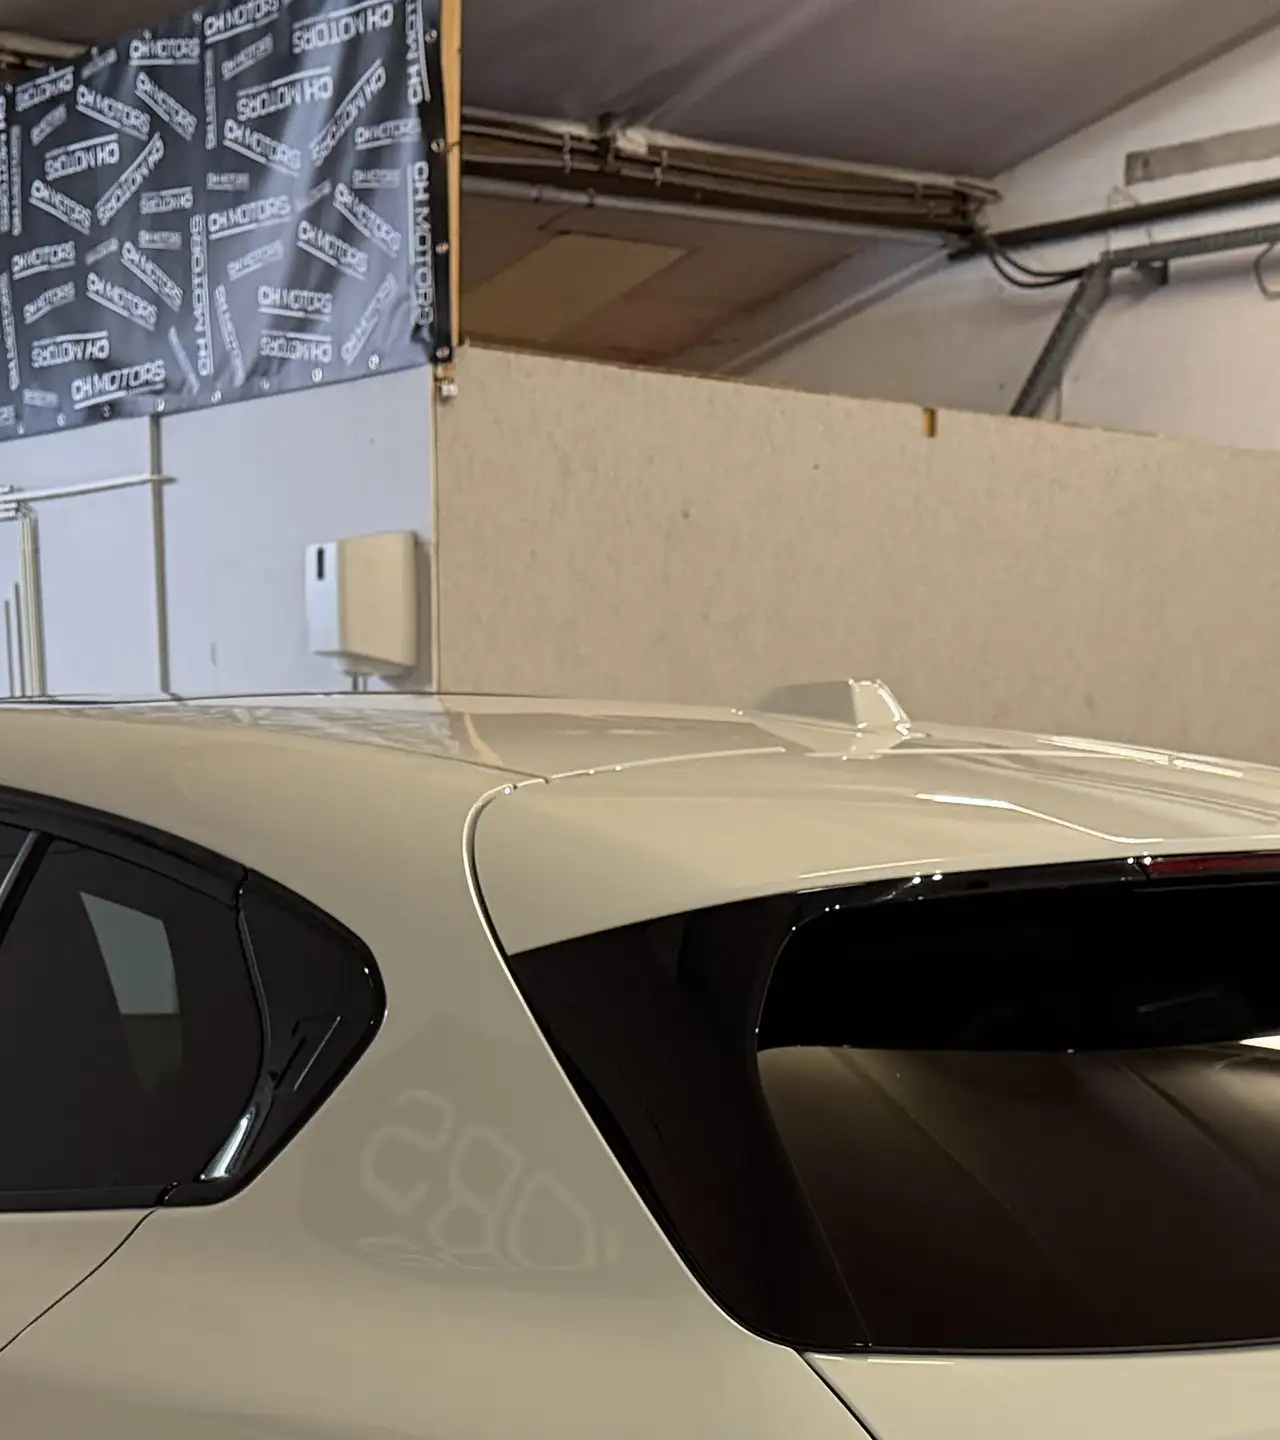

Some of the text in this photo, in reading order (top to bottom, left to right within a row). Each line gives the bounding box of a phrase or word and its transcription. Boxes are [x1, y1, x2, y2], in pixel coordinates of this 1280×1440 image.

[292, 3, 394, 54] CH MOTORS
[236, 75, 333, 121] CH MOTORS
[413, 161, 434, 325] CH MOTORS
[71, 376, 93, 402] CH
[92, 359, 166, 394] MOTORS
